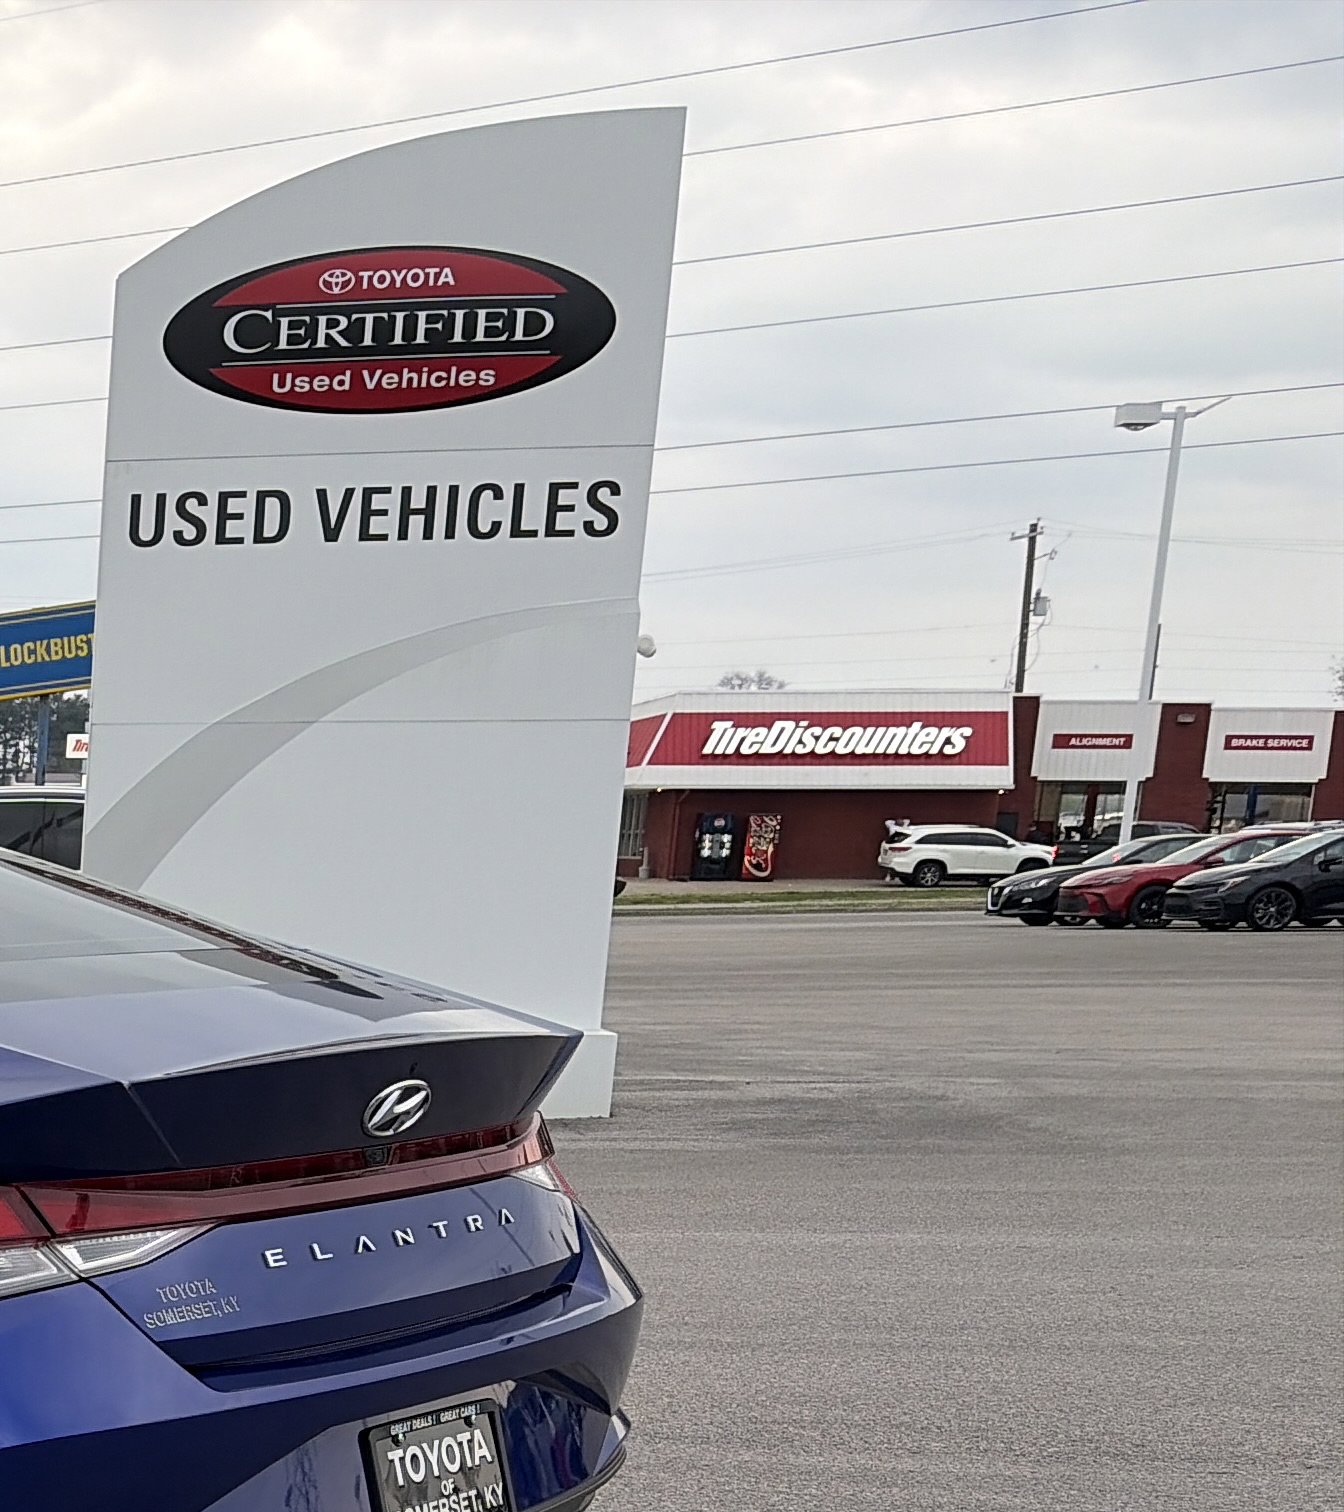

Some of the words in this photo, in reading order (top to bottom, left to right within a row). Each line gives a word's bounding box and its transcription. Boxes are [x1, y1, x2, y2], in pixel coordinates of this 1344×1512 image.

[359, 267, 455, 291] TOYOTA
[223, 306, 555, 354] CERTIFIED
[272, 369, 351, 394] Used
[362, 366, 497, 391] Vehicles
[128, 490, 292, 548] USED
[316, 480, 623, 543] VEHICLES
[1069, 737, 1127, 746] ALIGNMENT
[1231, 738, 1265, 747] BRAKE
[1266, 739, 1310, 748] SERVICE
[263, 1208, 515, 1269] ELANTRA
[156, 1278, 217, 1303] TOYOTA
[220, 1296, 240, 1313] KY
[390, 1421, 411, 1435] GREAT
[440, 1409, 460, 1423] GREAT
[387, 1428, 493, 1487] TOYOTA
[441, 1478, 455, 1495] OF
[484, 1482, 504, 1509] KY
